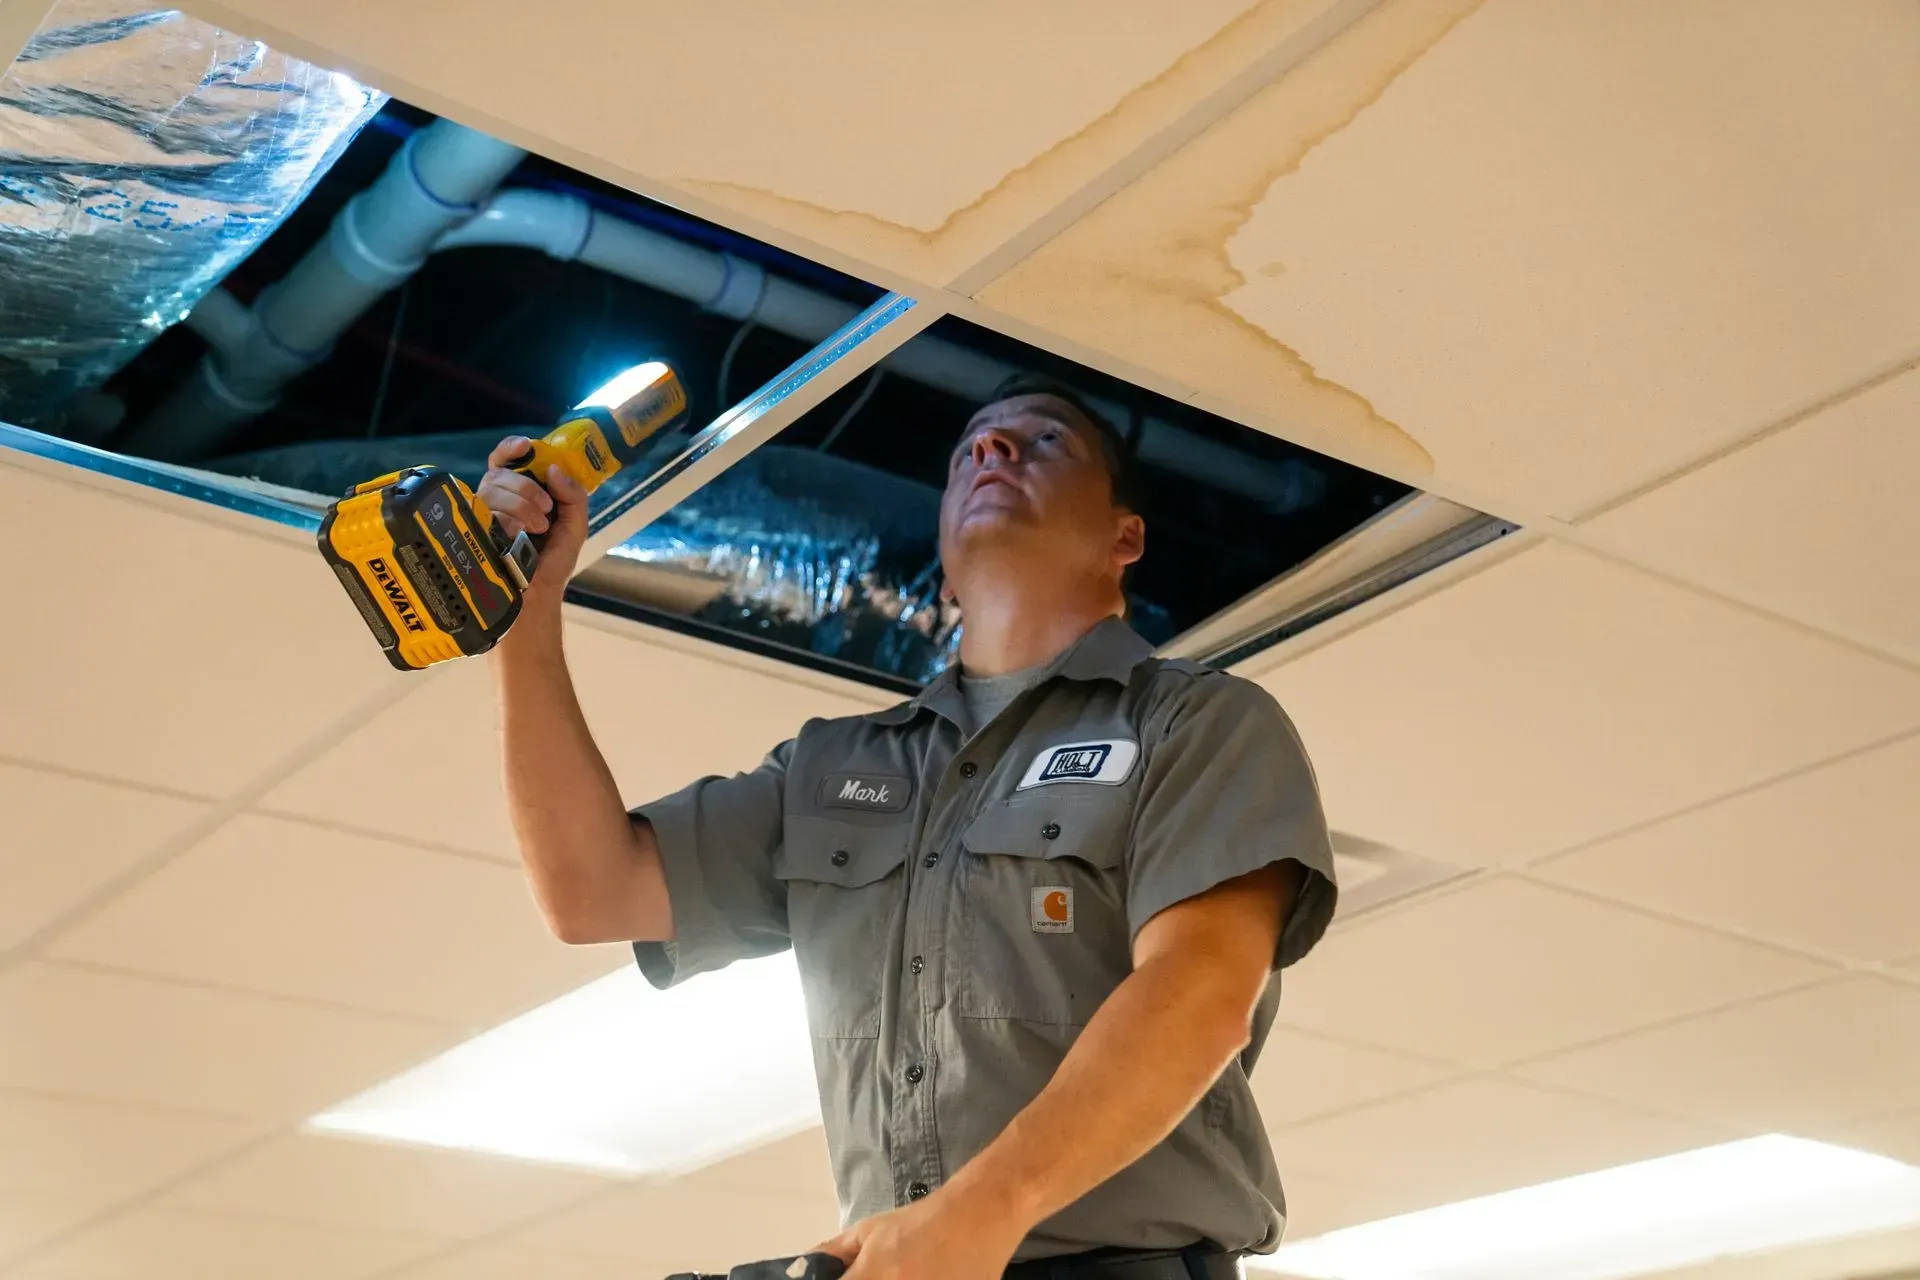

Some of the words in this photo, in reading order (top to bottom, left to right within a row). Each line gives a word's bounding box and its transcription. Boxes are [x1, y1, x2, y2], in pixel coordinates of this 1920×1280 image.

[368, 558, 426, 633] DEWALT
[1054, 751, 1101, 771] HOLT
[838, 779, 890, 803] Mark
